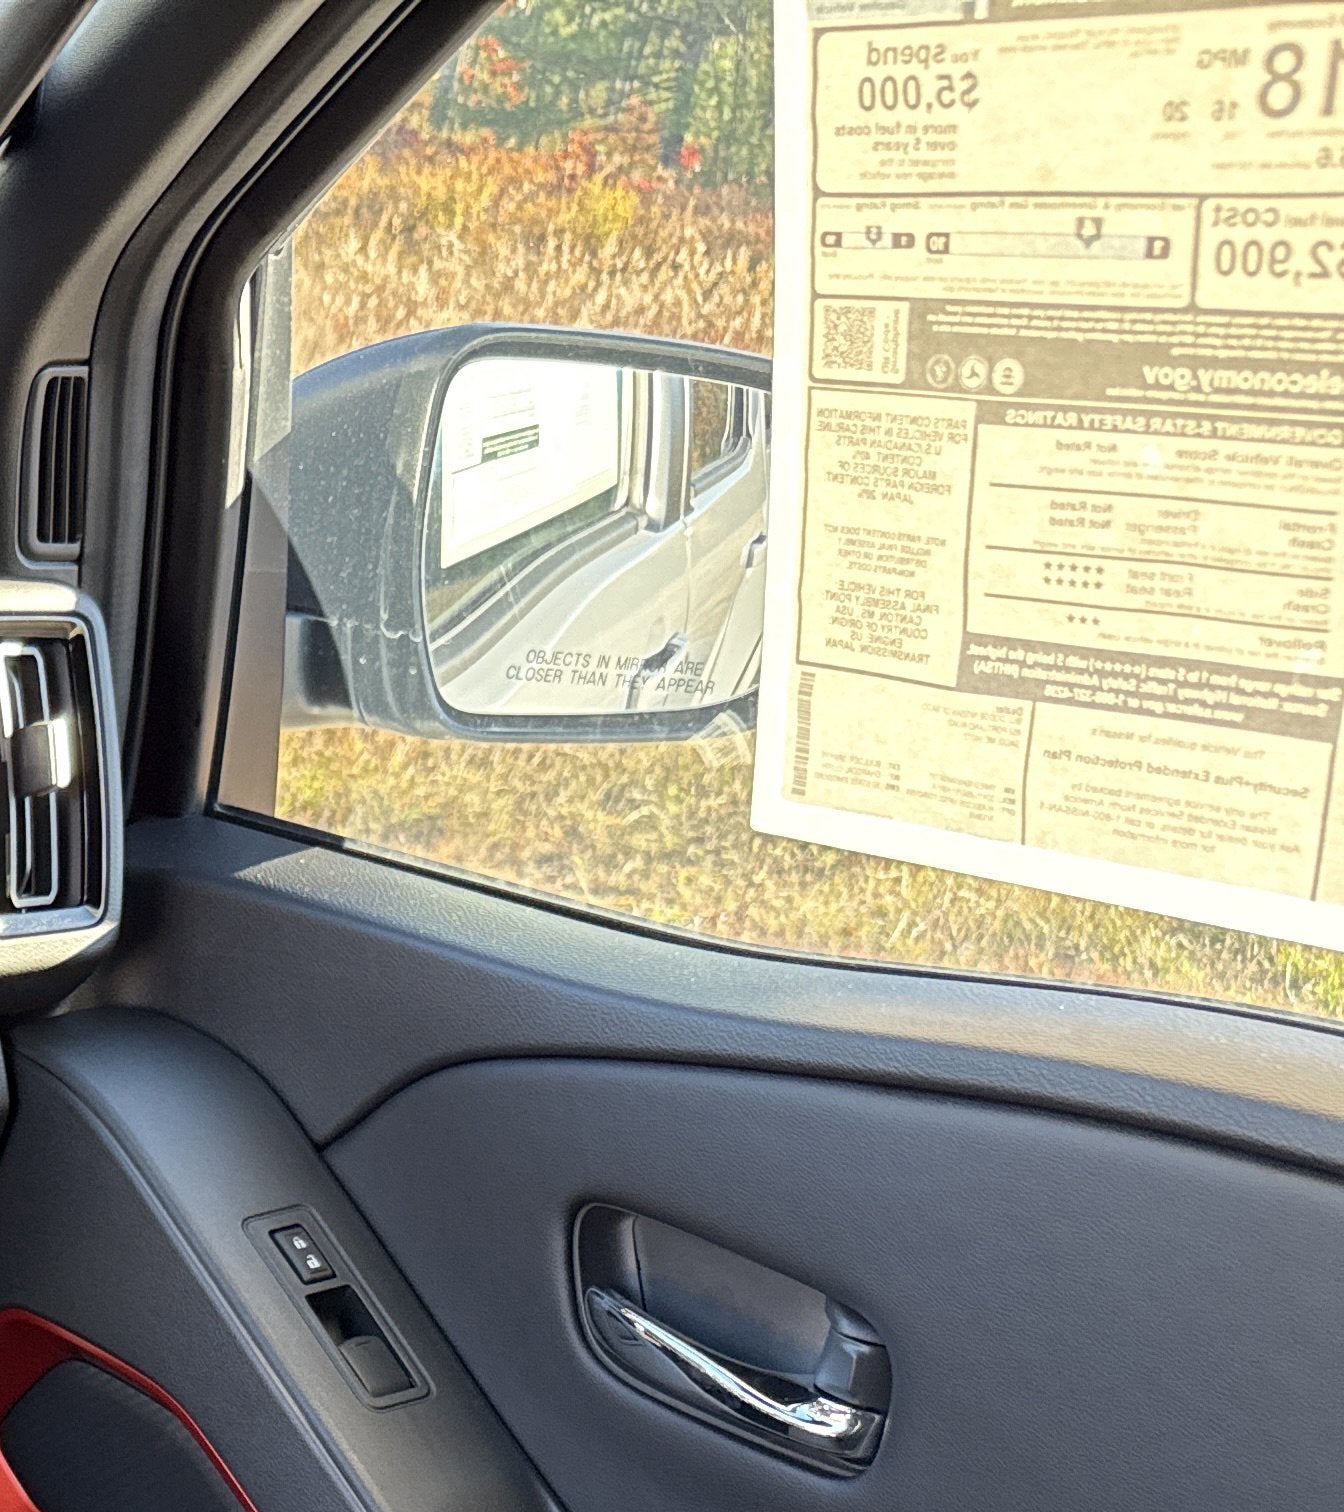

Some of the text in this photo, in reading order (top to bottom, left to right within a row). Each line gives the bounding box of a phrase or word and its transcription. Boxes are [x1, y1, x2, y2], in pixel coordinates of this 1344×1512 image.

[526, 649, 591, 667] OBJECTS
[596, 655, 611, 669] IN
[674, 662, 705, 677] ARE
[506, 665, 715, 695] CLOSER THAN THEY APPEAR
